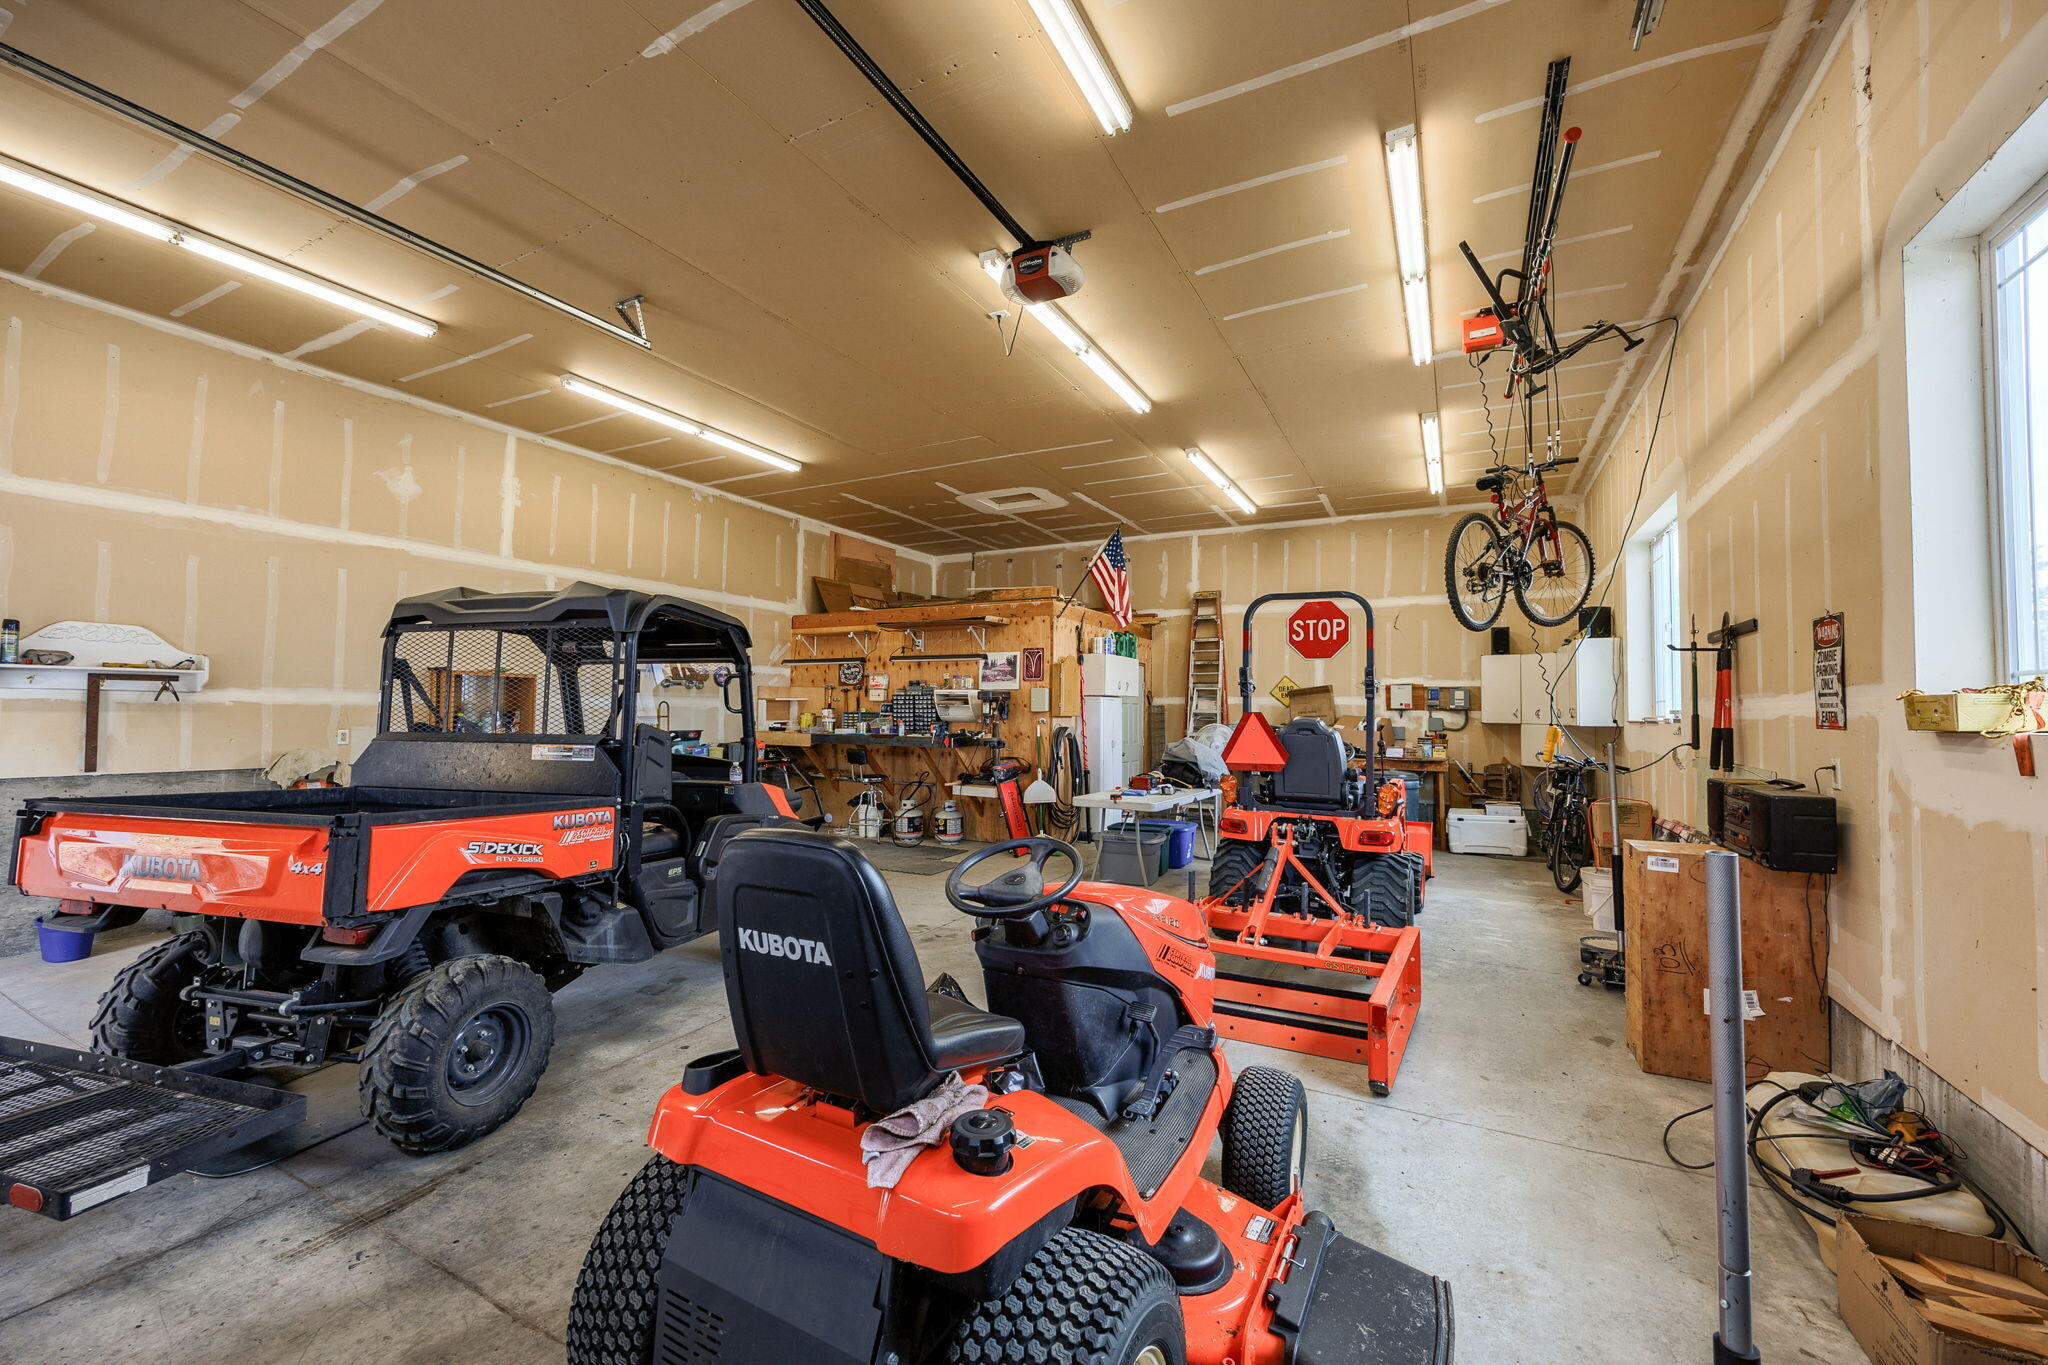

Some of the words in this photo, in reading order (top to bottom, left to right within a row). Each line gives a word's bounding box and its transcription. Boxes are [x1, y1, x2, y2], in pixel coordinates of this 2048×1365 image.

[1291, 618, 1346, 641] STOP
[1817, 649, 1837, 664] ZOMBIE
[1816, 663, 1838, 677] PARKING
[1821, 678, 1834, 691] ONLY
[1821, 710, 1838, 724] EATEN
[553, 811, 612, 830] KUBOTA
[467, 841, 544, 855] SIDEKICK
[496, 855, 544, 863] RTV-XG850
[122, 853, 201, 882] KUBOTA
[290, 861, 323, 876] 4x4
[738, 926, 832, 967] KUBOTA
